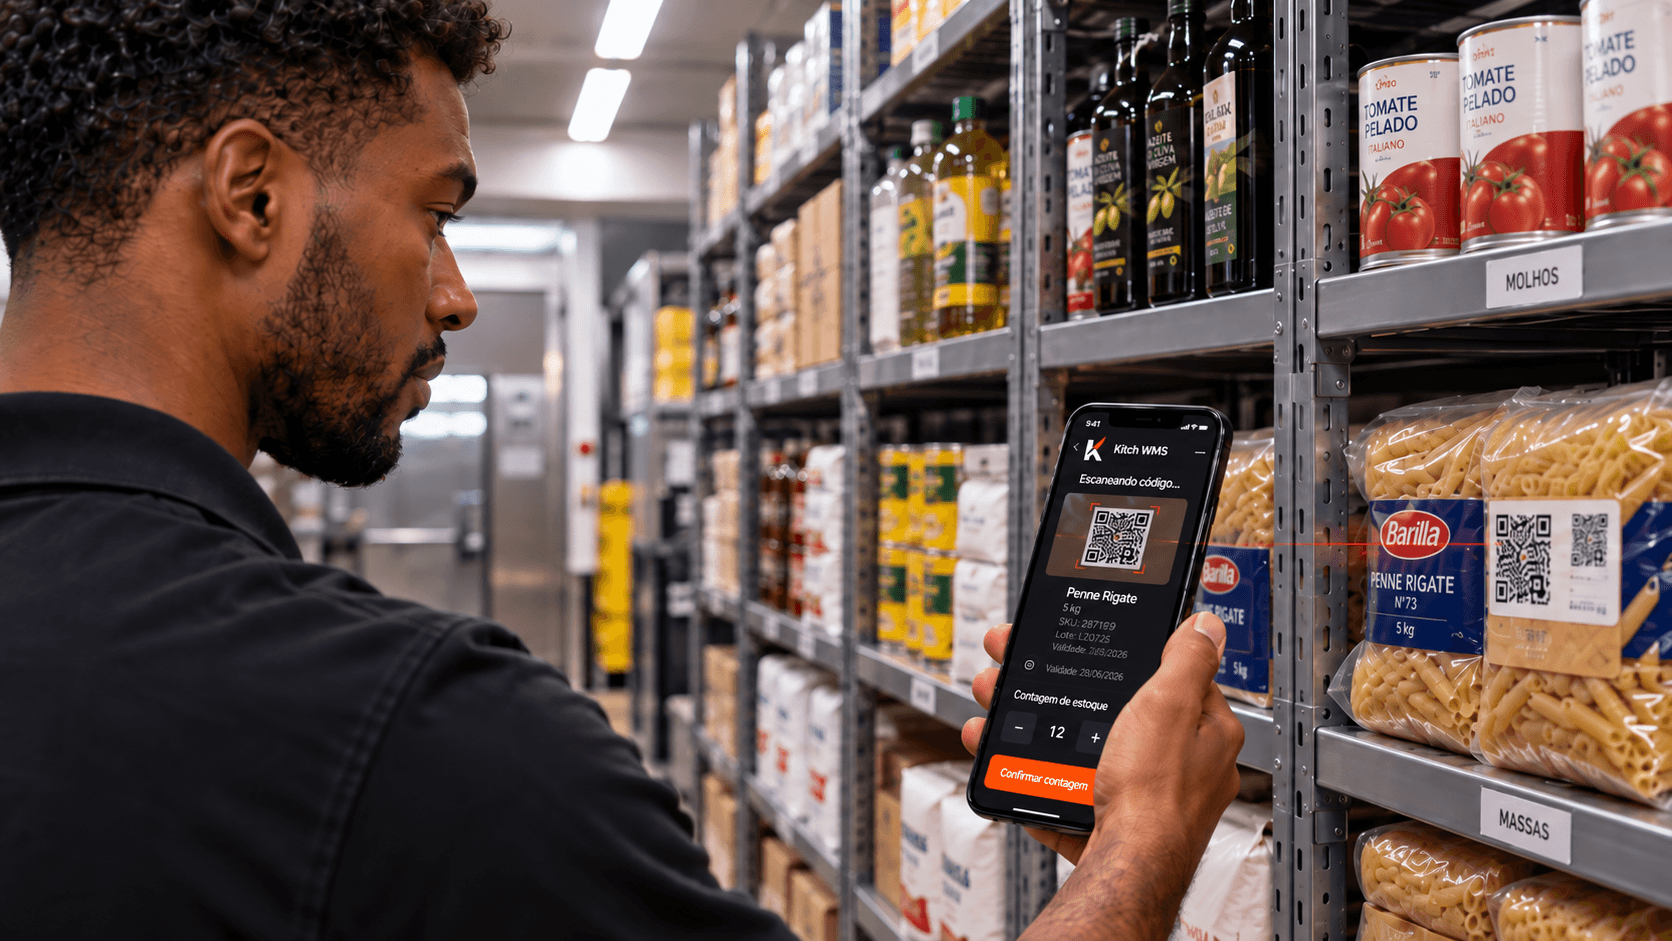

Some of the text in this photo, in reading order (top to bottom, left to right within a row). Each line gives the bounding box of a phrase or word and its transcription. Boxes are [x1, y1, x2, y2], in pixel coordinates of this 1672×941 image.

[1462, 64, 1516, 93] TOMATE
[1364, 95, 1418, 120] TOMATE
[1463, 86, 1517, 114] PELADO
[1365, 115, 1418, 139] PELADO
[1506, 267, 1559, 291] MOLHOS
[1113, 444, 1168, 456] Kitch WMS
[1079, 473, 1180, 490] Escaneando código...
[1386, 520, 1441, 547] Barilla
[1202, 561, 1235, 586] Barilla
[1371, 571, 1455, 594] PENNE RIGATE
[1066, 586, 1138, 605] Penne Rigate
[1069, 604, 1081, 615] kg
[1396, 621, 1415, 639] 5 kg
[1014, 689, 1108, 711] Contagem de estoque
[1050, 725, 1065, 739] 12
[1000, 767, 1088, 791] Confirmar contagem
[1500, 808, 1549, 840] MASSAS
